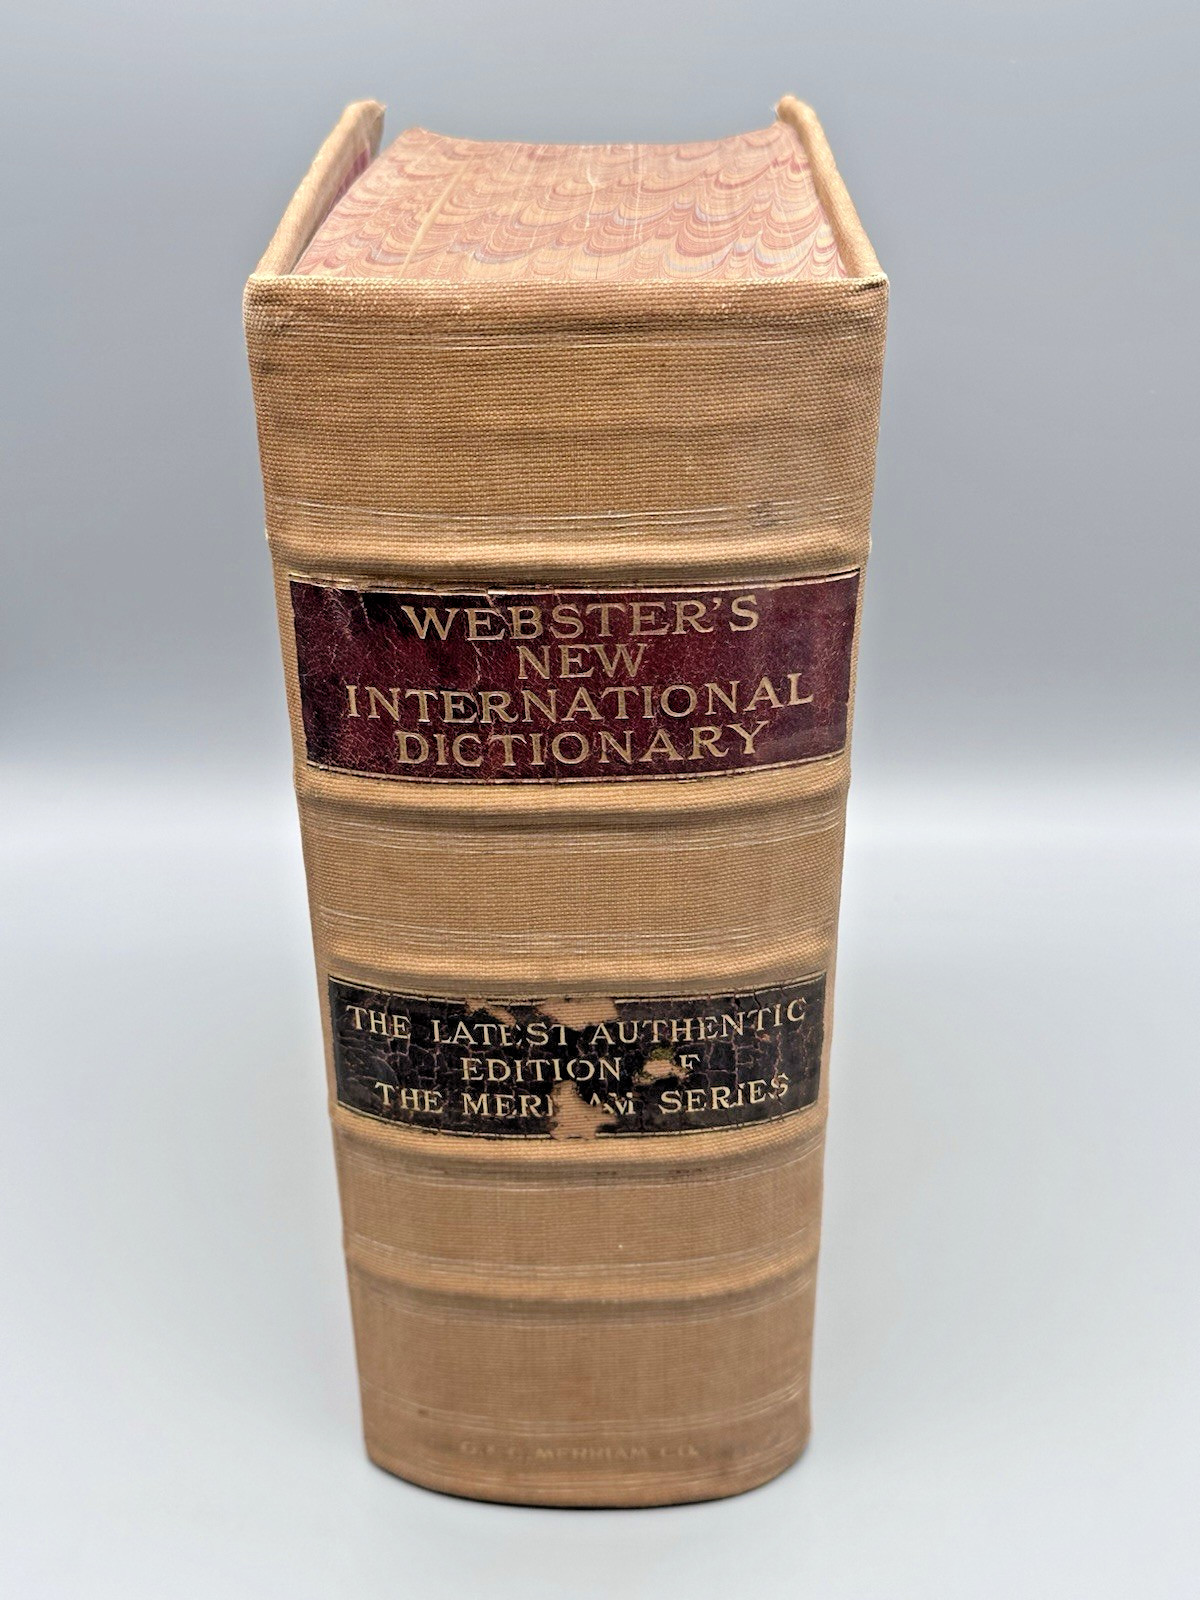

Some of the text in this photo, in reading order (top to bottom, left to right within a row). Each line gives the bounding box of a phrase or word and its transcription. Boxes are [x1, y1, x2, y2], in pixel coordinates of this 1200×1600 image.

[401, 594, 760, 641] WEBSTER'S
[517, 642, 650, 681] NEW
[345, 672, 814, 724] INTERNATIONAL
[394, 720, 769, 768] DICTIONARY
[345, 998, 807, 1046] THE LATEST AUTHENTIC
[461, 1057, 621, 1082] EDITION
[375, 1082, 444, 1114] THE
[659, 1073, 789, 1114] SERIES
